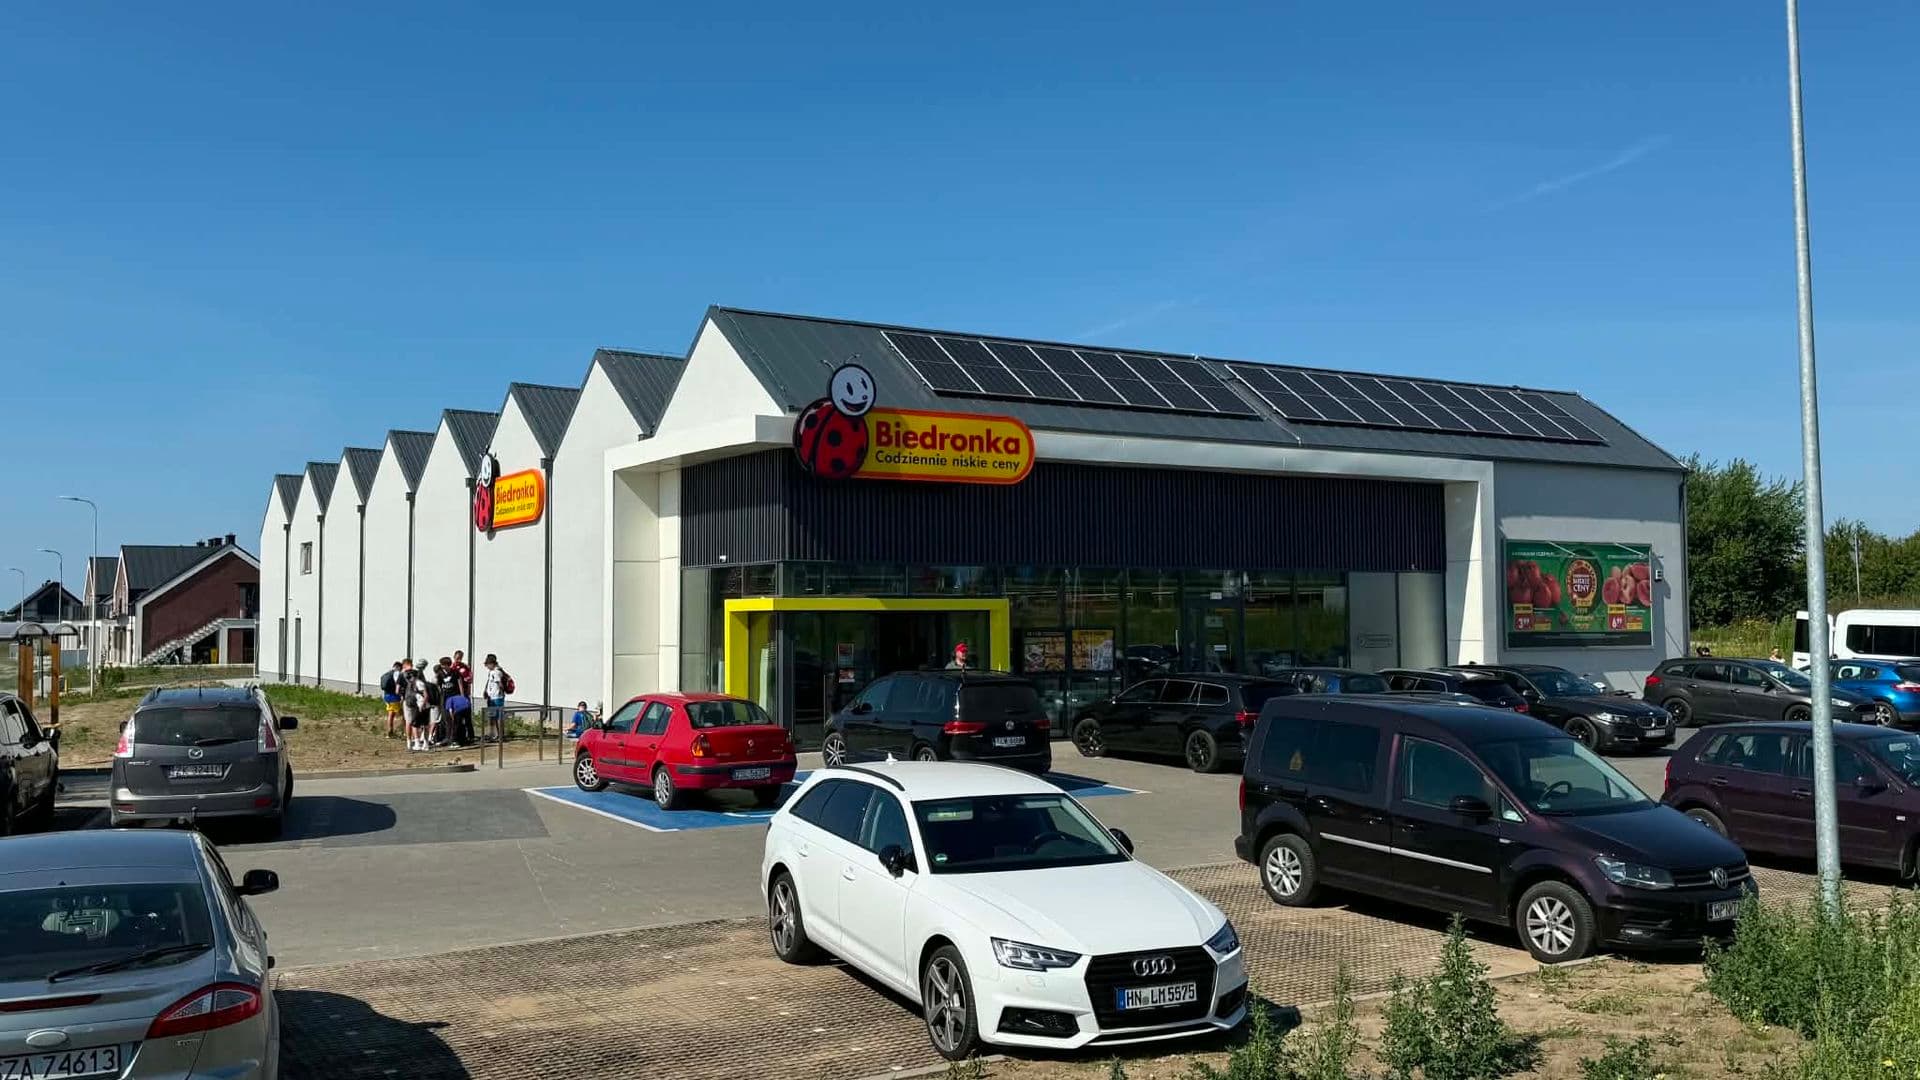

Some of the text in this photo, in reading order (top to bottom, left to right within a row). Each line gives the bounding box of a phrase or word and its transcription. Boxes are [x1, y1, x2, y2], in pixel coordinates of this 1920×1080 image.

[876, 421, 1020, 454] Biedronka
[876, 451, 1020, 472] Codziennie niskie ceny
[496, 480, 534, 504] Biedronka
[1126, 989, 1142, 1007] HN
[0, 1049, 116, 1080] ZA 74613
